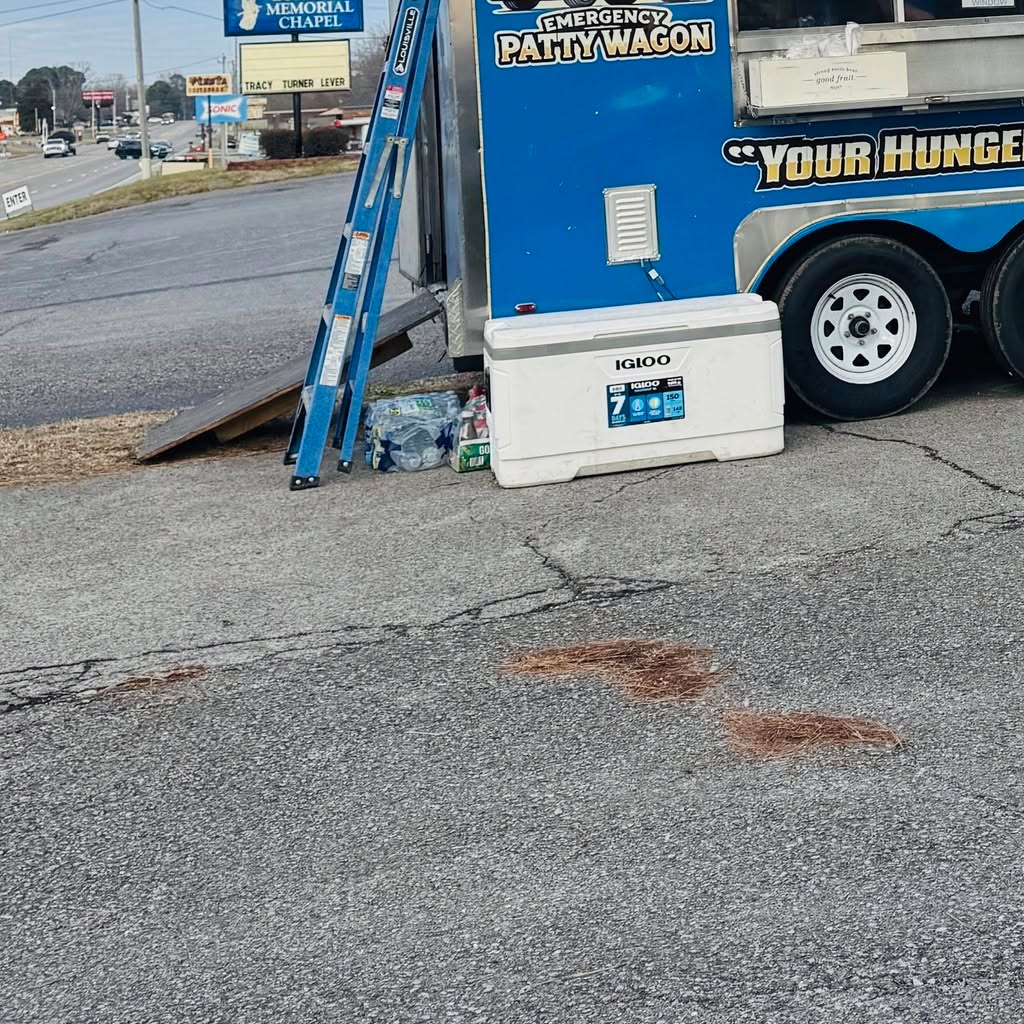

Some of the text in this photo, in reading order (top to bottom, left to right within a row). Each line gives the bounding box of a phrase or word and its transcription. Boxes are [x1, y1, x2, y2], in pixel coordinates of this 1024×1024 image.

[266, 0, 355, 16] MEMORIAL
[278, 15, 343, 29] CHAPEL
[544, 9, 667, 32] EMERGENCY
[400, 8, 416, 64] LOUISVILLE
[500, 23, 711, 63] PATTY WAGON
[245, 77, 345, 91] TRACY TURNER LEVER
[5, 190, 28, 208] ENTER
[615, 354, 671, 371] IGLOO
[630, 380, 660, 390] IGLOO
[610, 394, 626, 415] 7
